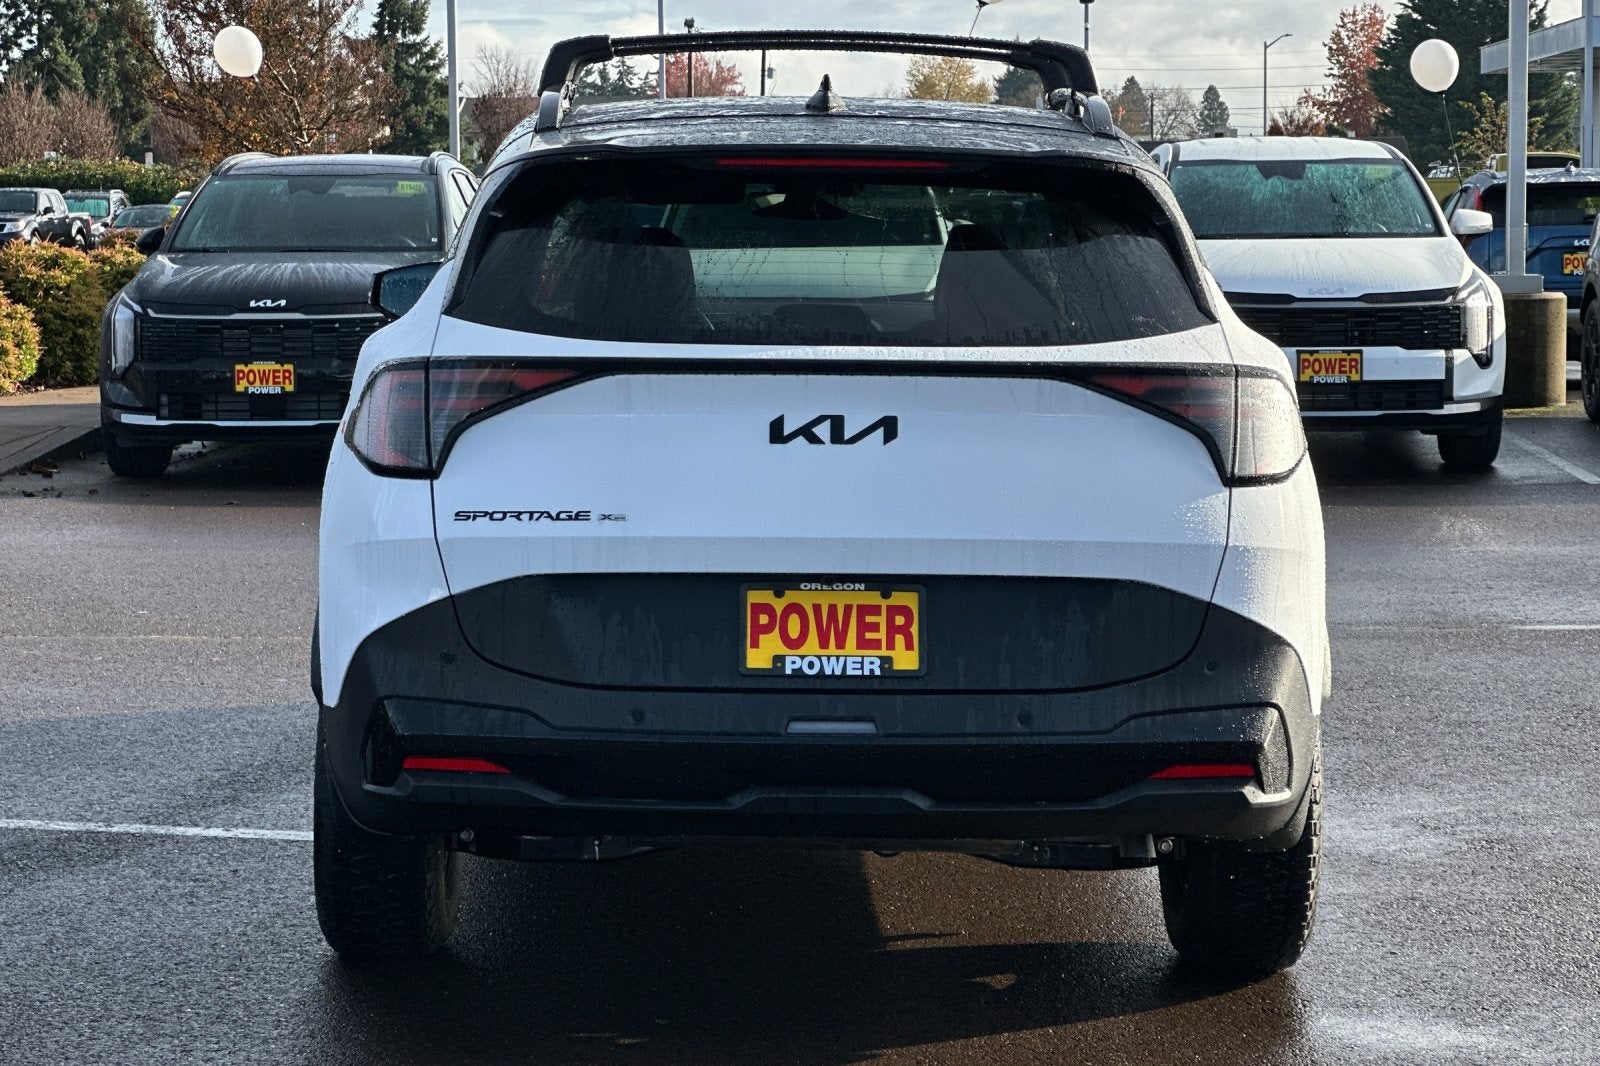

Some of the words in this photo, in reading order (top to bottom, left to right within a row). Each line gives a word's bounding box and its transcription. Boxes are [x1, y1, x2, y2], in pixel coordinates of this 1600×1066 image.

[1301, 358, 1359, 375] POWER
[236, 369, 292, 386] POWER
[769, 413, 898, 445] KIA
[453, 510, 592, 521] SPORTAGE
[800, 583, 866, 591] OREGON
[749, 602, 915, 651] POWER
[785, 656, 881, 676] POWER
